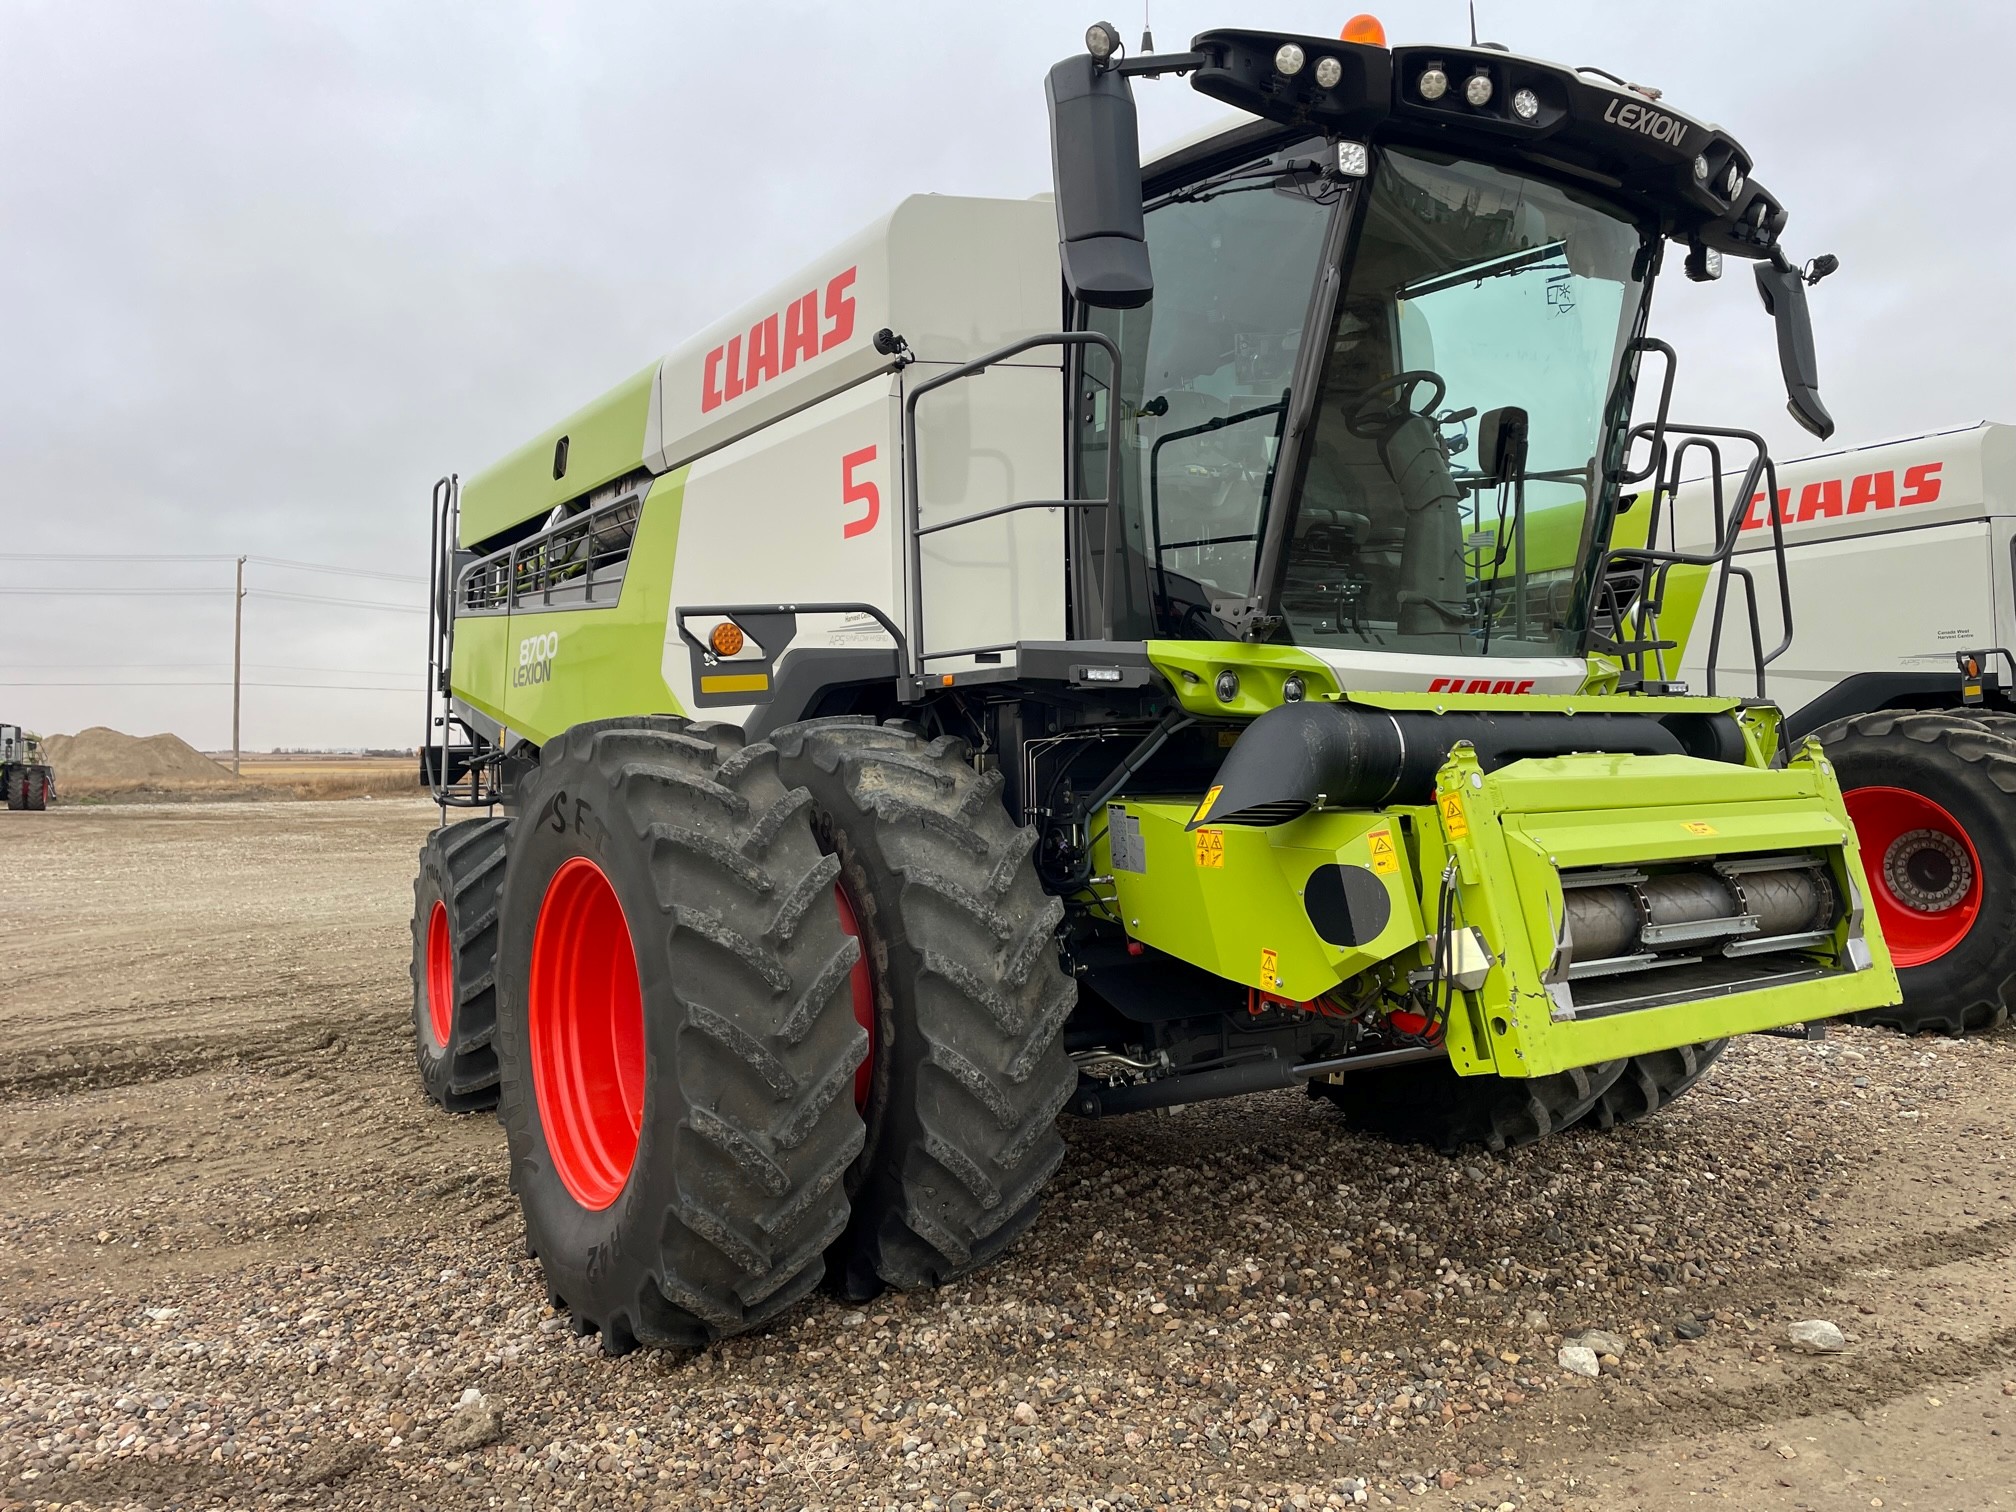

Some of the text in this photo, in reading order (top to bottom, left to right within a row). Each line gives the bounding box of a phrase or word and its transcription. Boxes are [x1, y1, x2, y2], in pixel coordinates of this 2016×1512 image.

[1603, 98, 1689, 147] LEXION
[701, 264, 857, 414] CLAAS
[842, 444, 880, 540] 5
[1739, 461, 1944, 532] CLAAS
[519, 631, 559, 666] 8700
[829, 634, 845, 646] APS
[512, 659, 552, 688] LEXION
